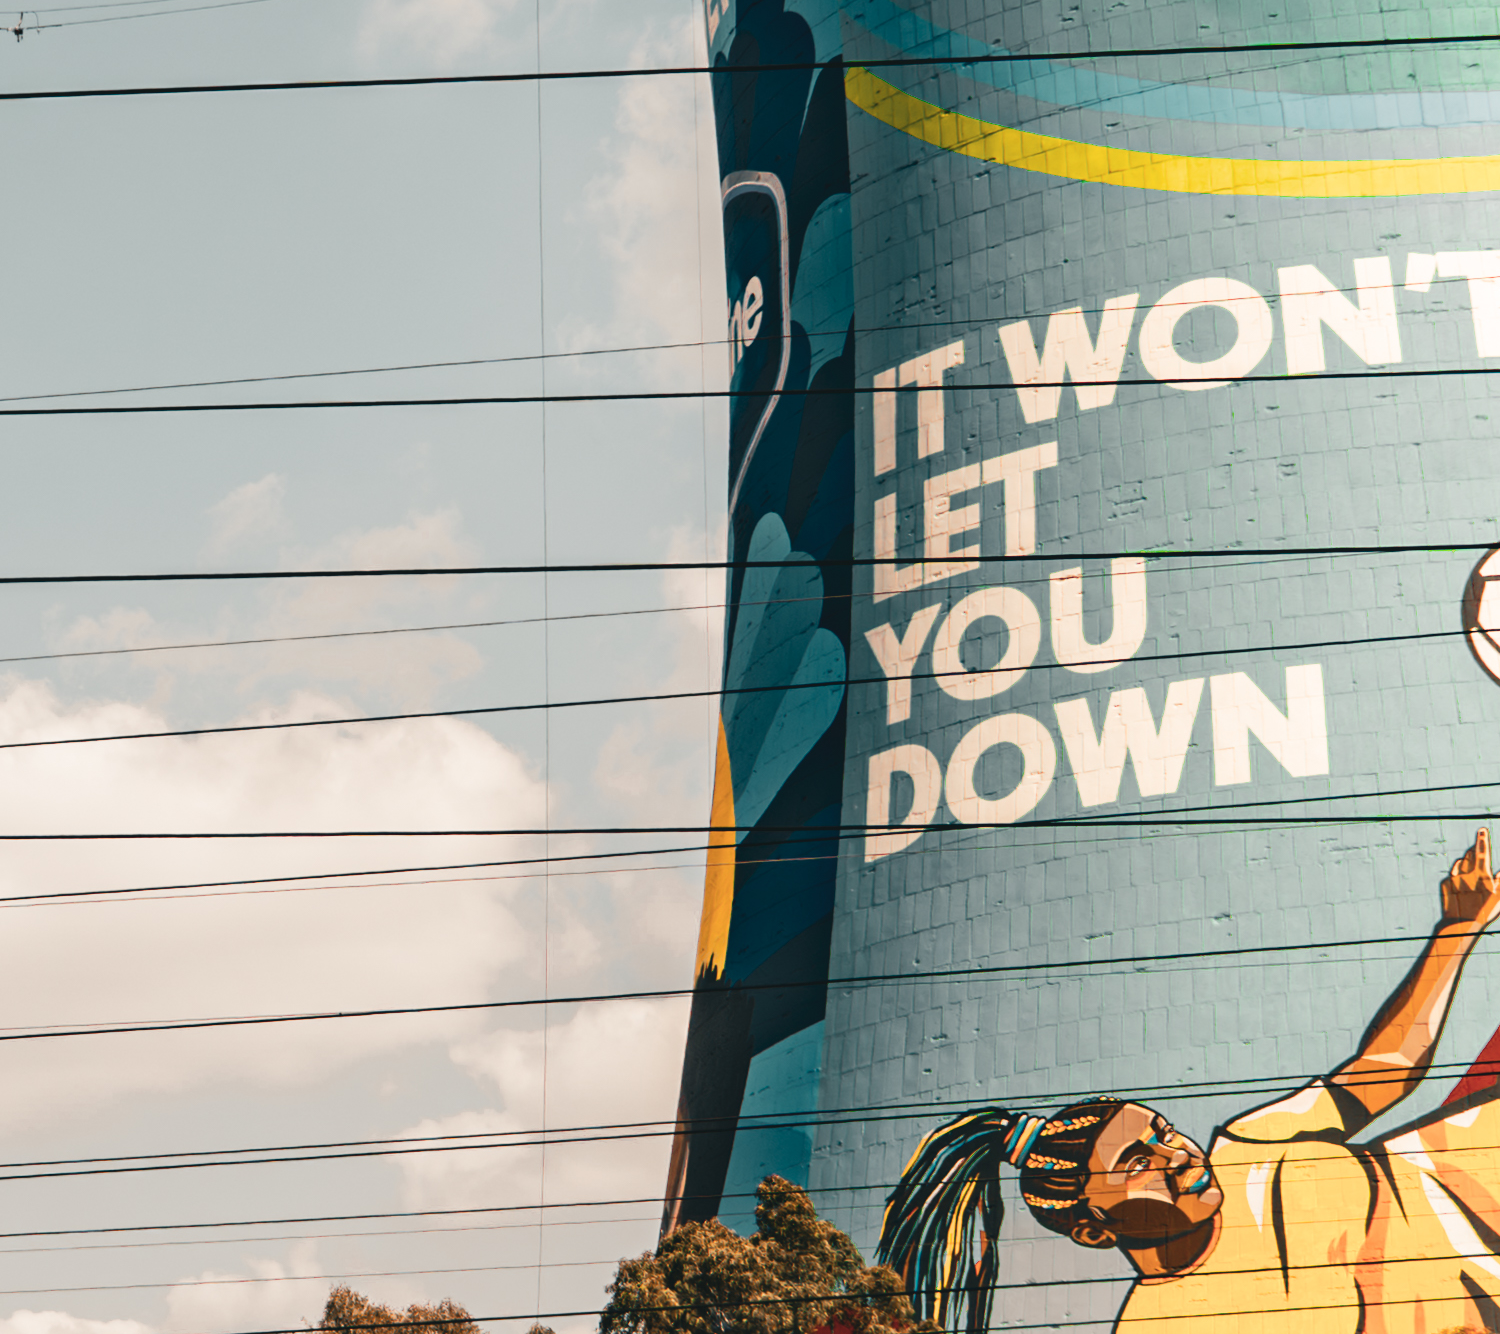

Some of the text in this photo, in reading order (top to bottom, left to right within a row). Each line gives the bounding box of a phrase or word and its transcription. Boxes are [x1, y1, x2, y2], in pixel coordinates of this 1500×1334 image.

[873, 339, 965, 477] IT
[873, 441, 1059, 600] LET
[863, 556, 1149, 724] YOU
[863, 664, 1331, 864] DOWN
